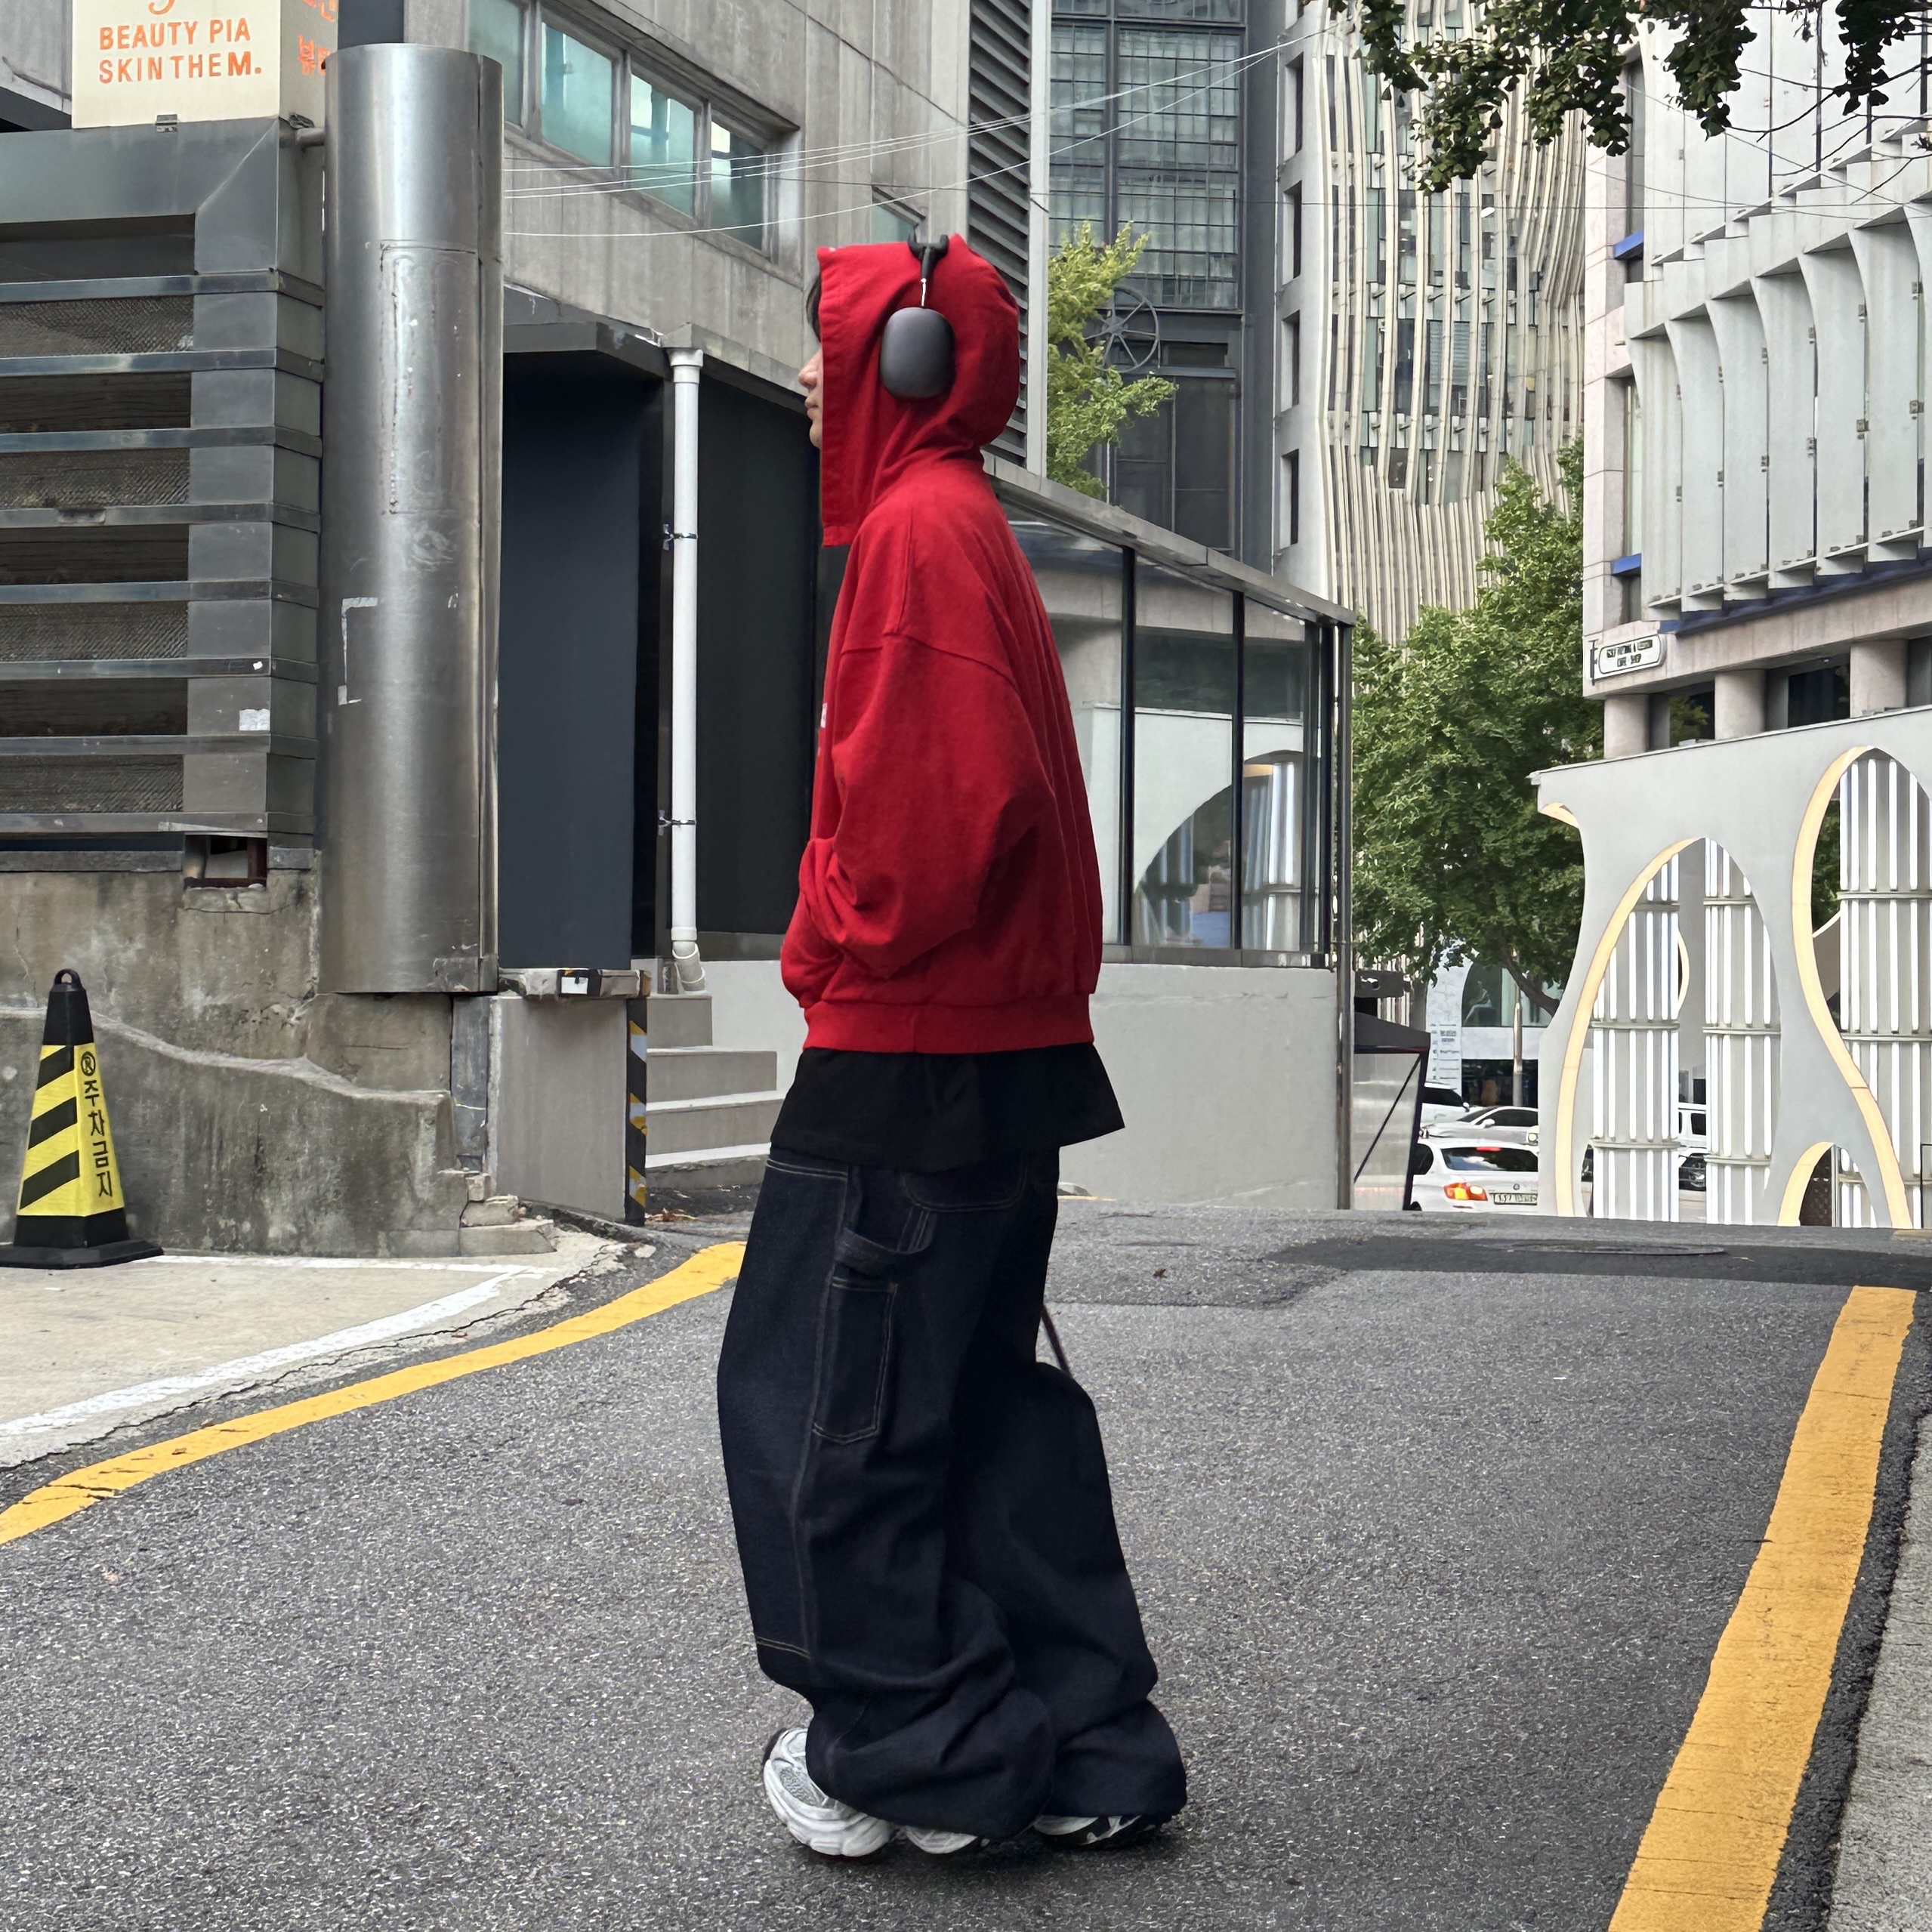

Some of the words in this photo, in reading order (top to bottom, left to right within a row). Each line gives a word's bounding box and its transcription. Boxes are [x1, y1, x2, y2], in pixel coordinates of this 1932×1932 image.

[99, 20, 198, 51] BEAUTY
[209, 17, 252, 43] PIA
[84, 1079, 113, 1198] 주차금지
